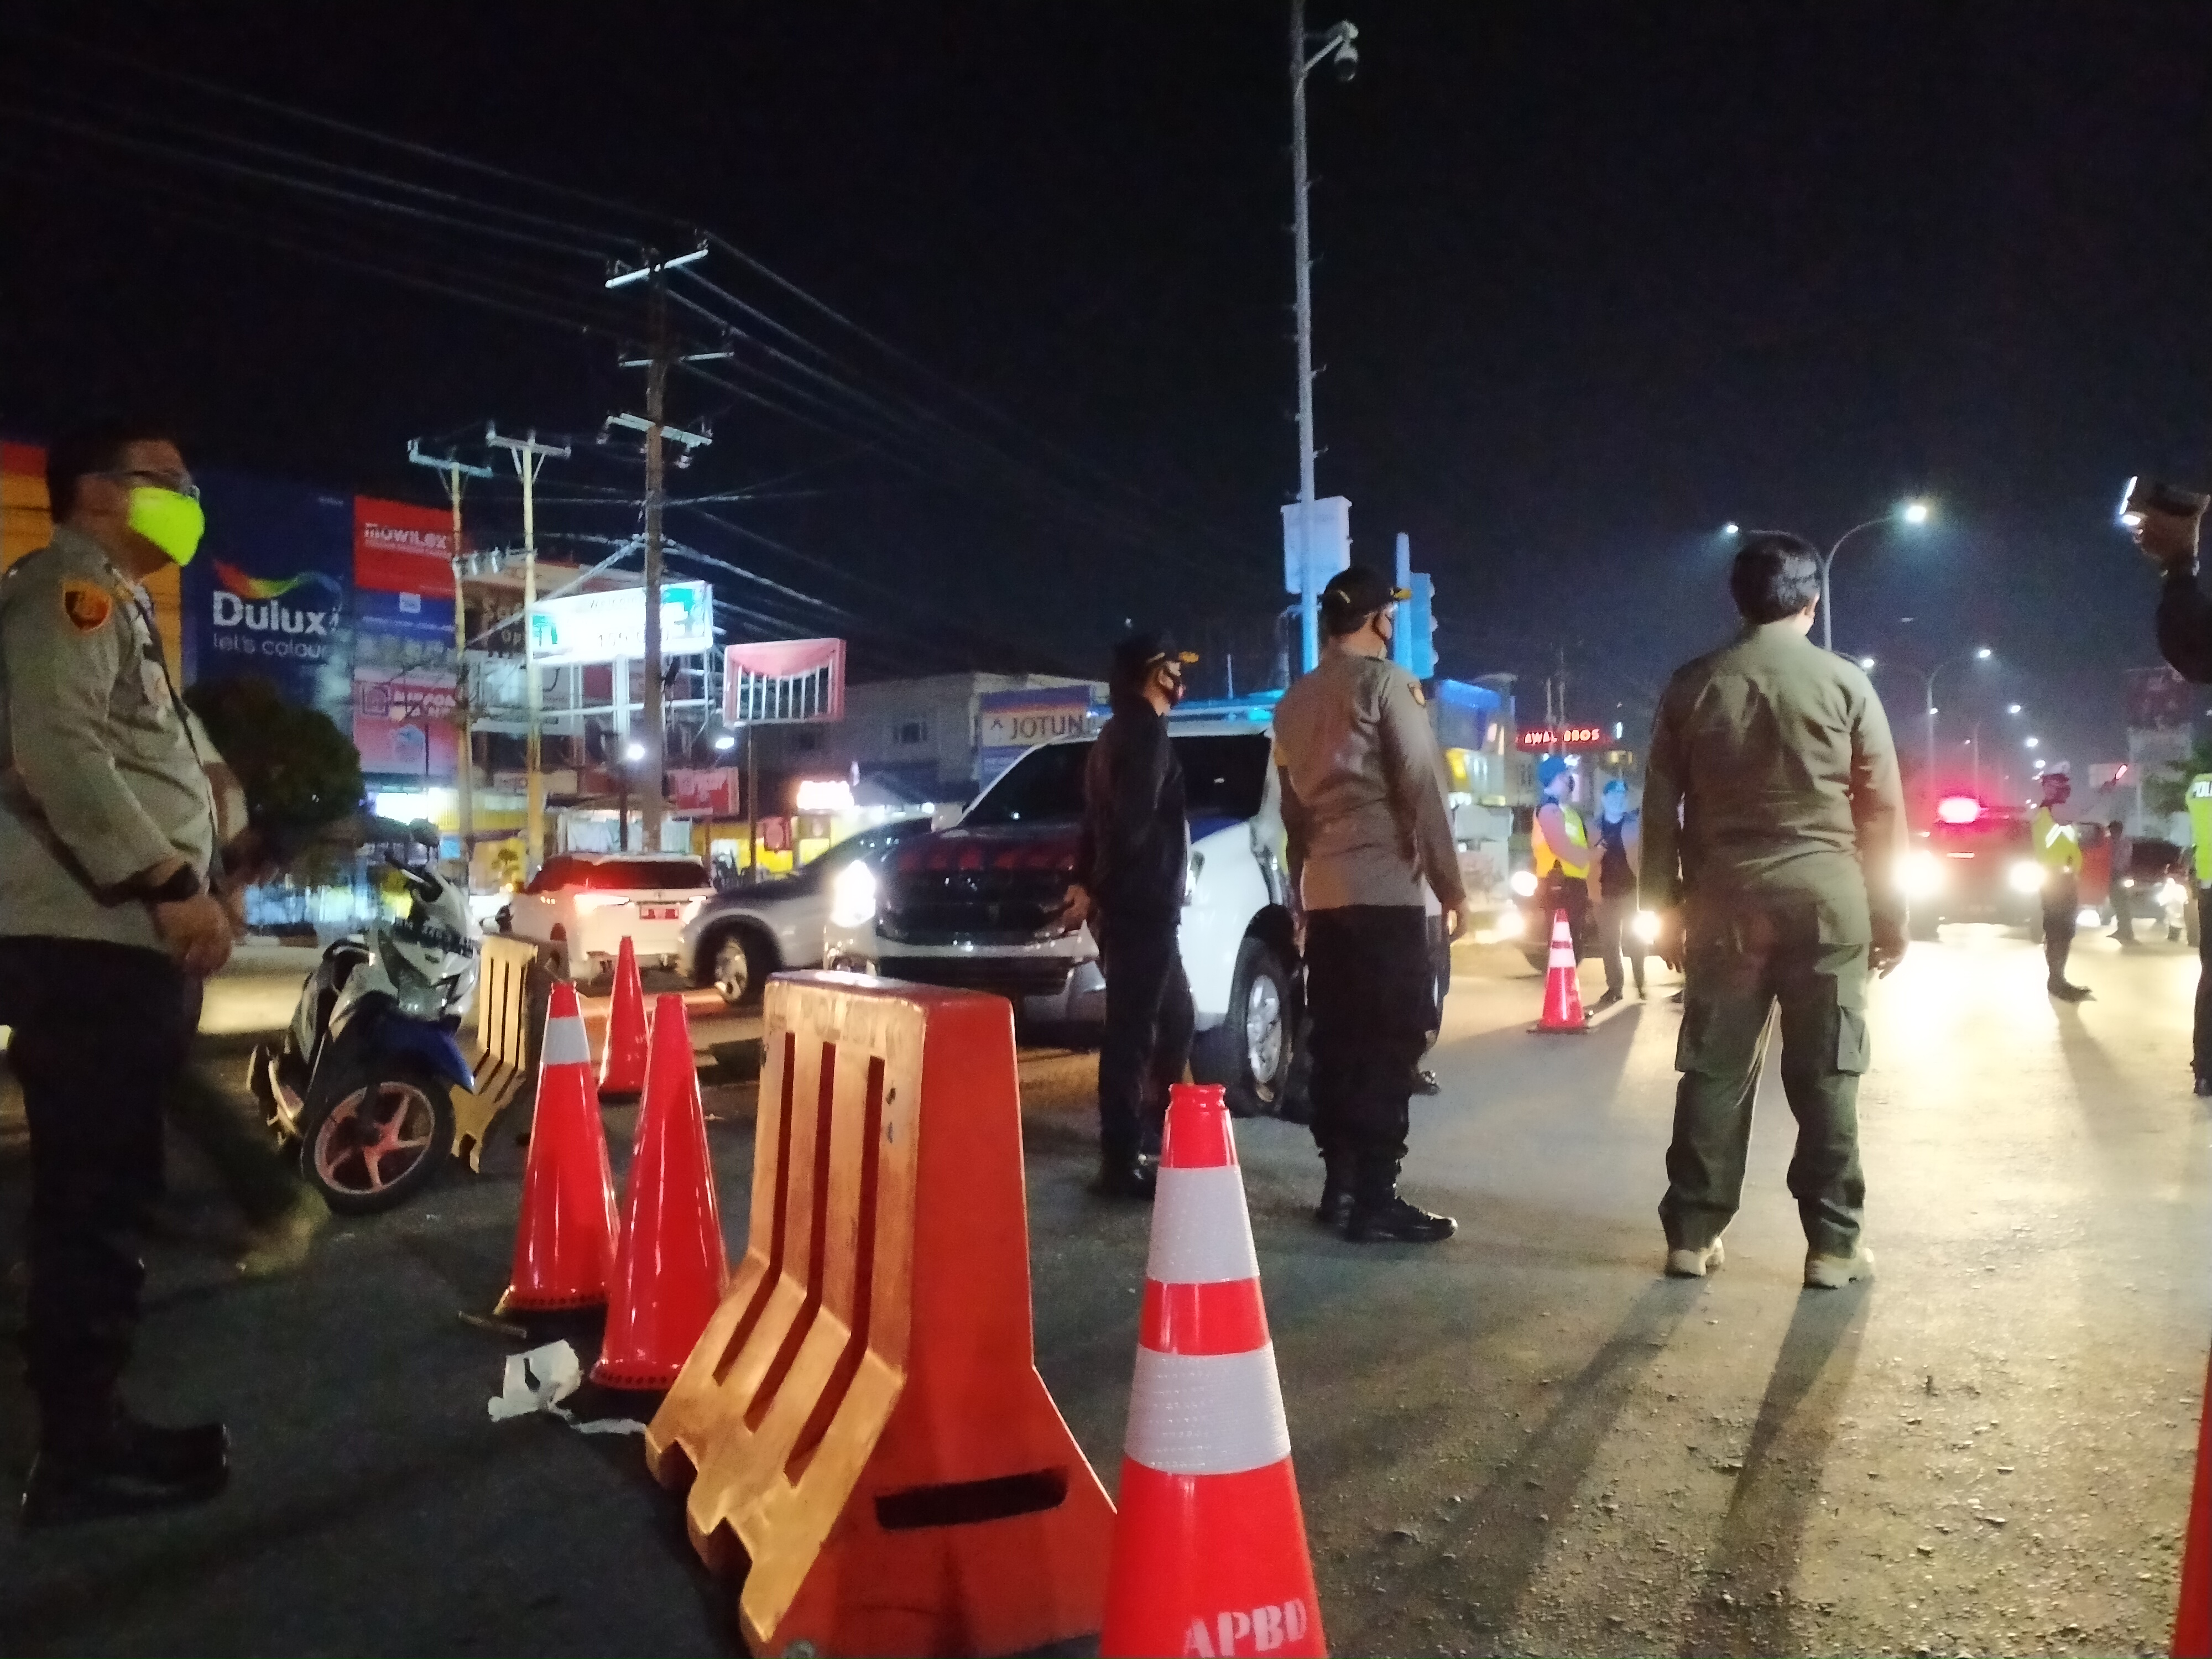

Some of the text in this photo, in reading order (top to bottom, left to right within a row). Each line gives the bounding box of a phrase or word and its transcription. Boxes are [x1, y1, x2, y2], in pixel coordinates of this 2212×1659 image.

[212, 591, 327, 636] Dulux
[1010, 714, 1083, 740] JOTUN
[1525, 731, 1557, 744] AWAL
[1182, 1598, 1307, 1658] APBD
